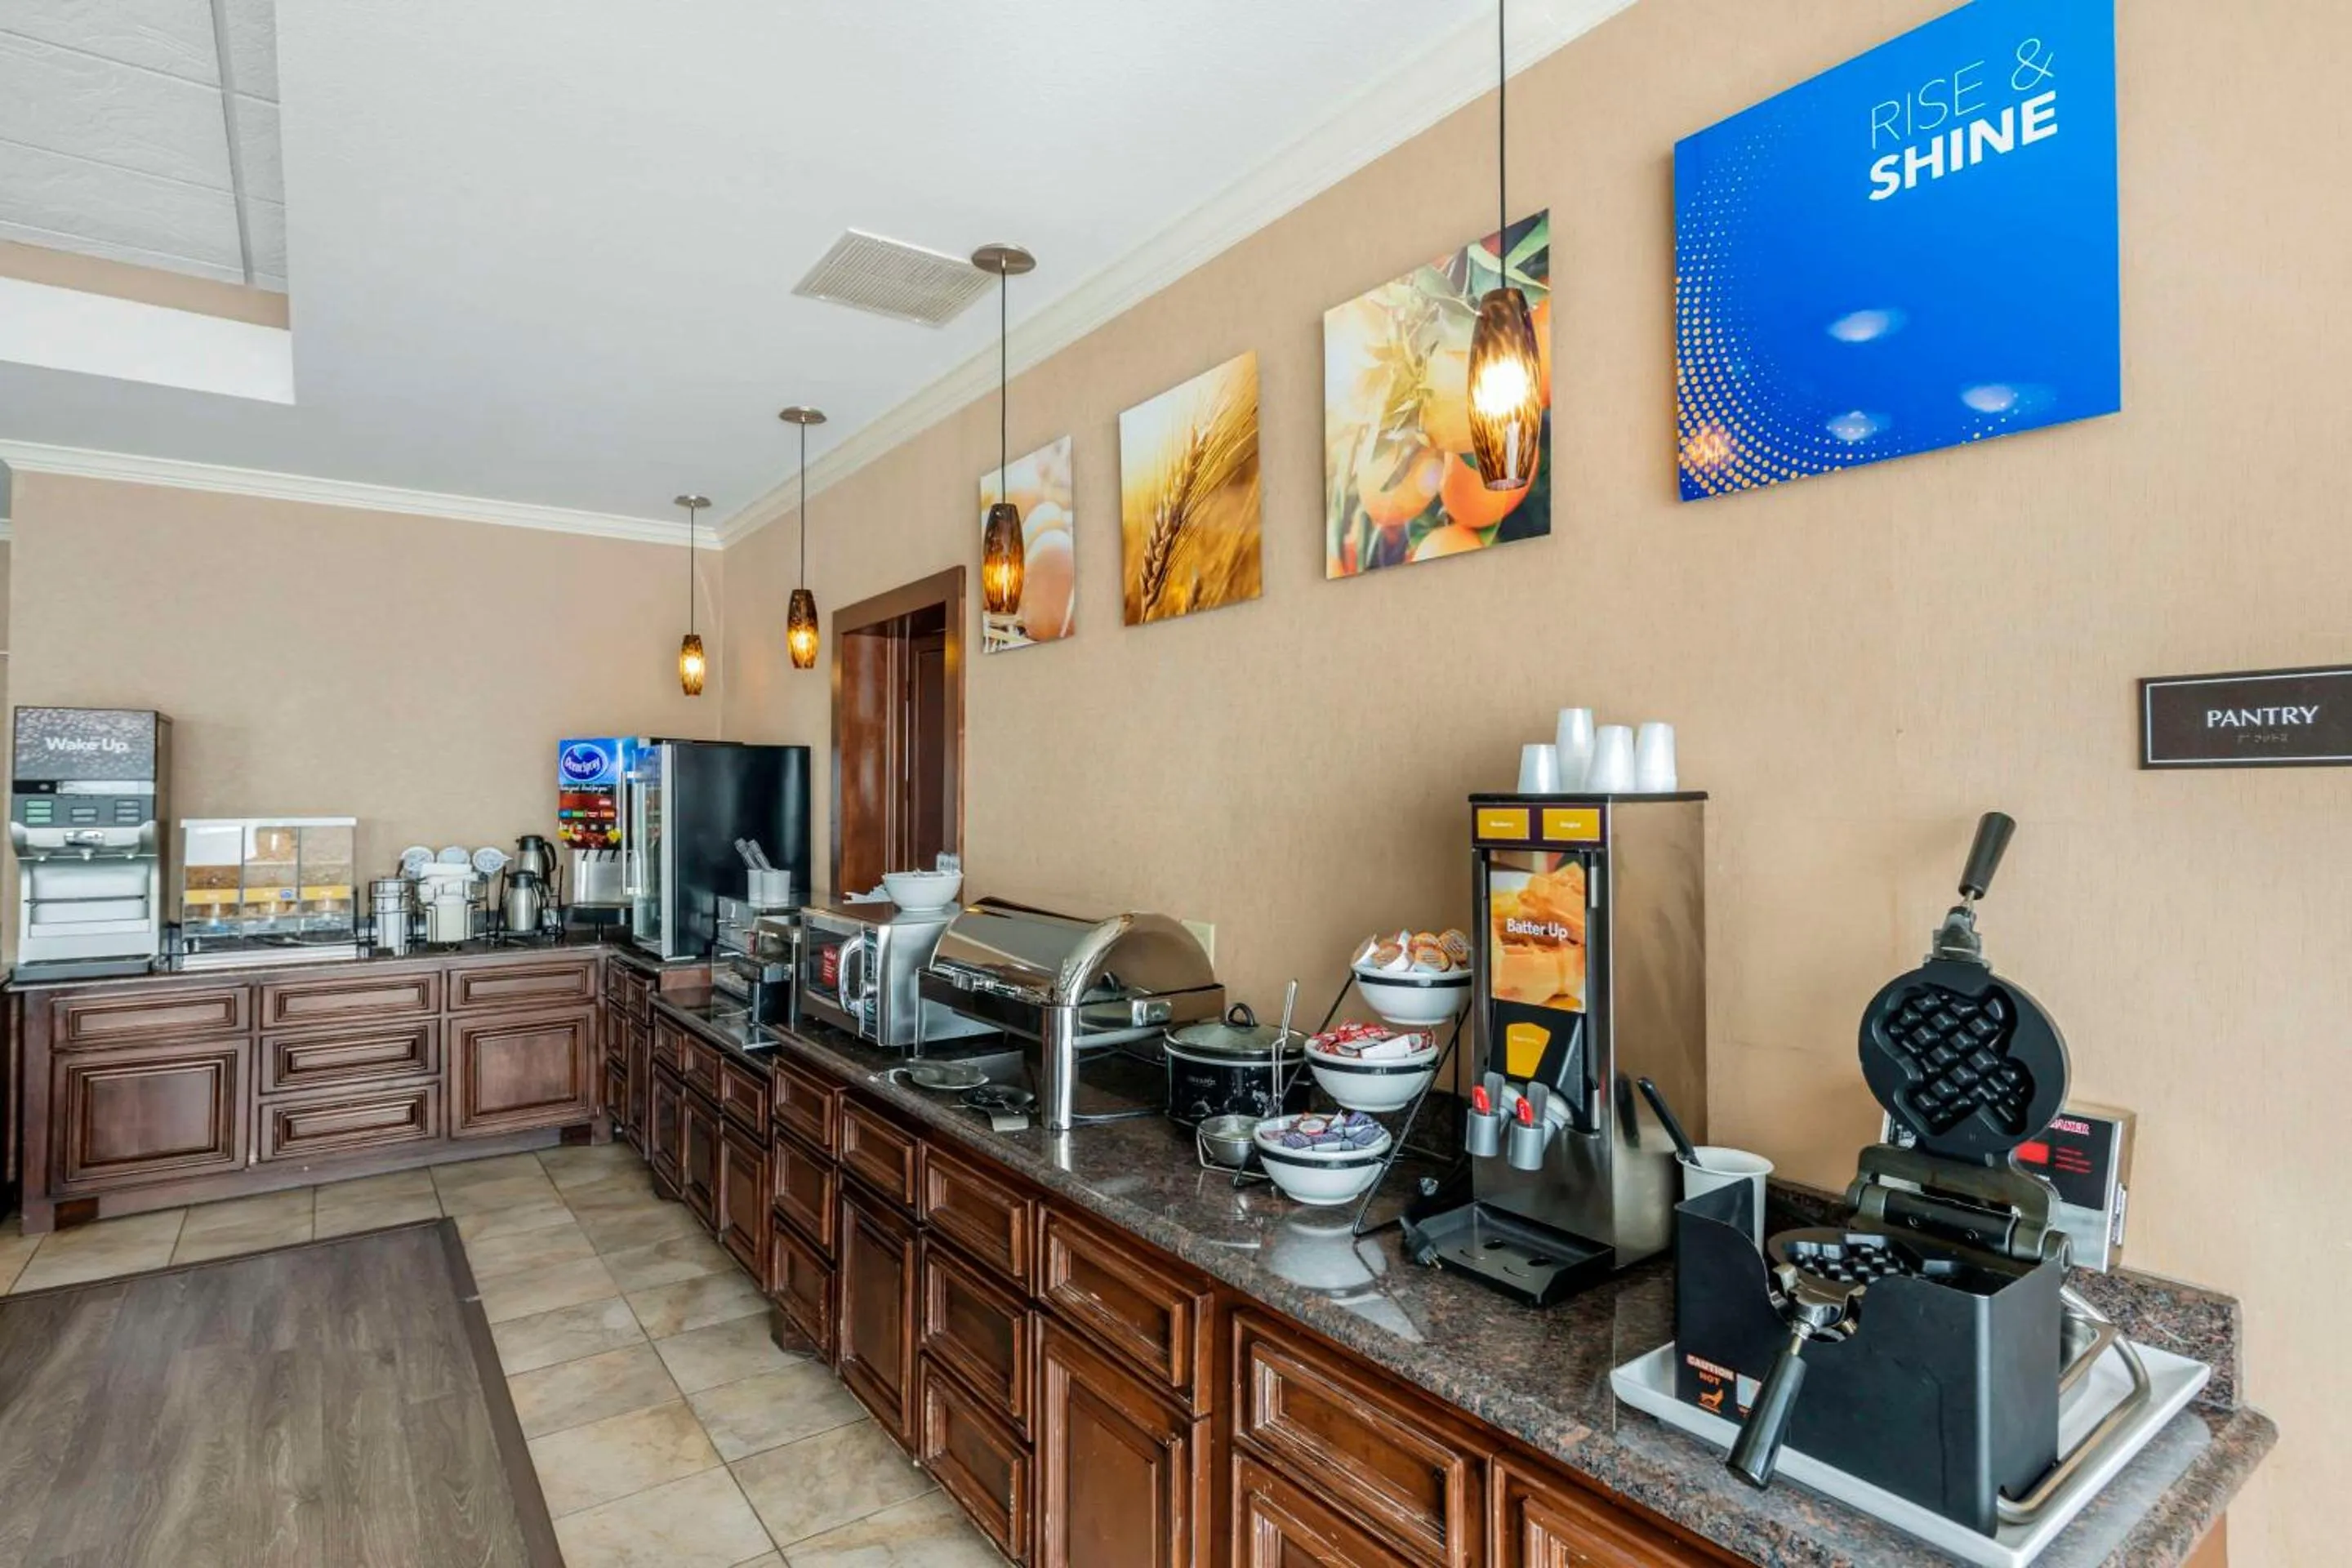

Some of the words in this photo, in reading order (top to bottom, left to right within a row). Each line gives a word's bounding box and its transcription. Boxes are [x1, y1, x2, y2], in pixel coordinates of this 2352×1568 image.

[1871, 60, 1987, 150] RISE
[2011, 38, 2055, 91] &
[1869, 90, 2058, 201] SHINE
[2207, 705, 2319, 728] PANTRY
[45, 737, 100, 751] Wake
[1507, 918, 1546, 936] Batter
[1548, 921, 1568, 942] Up
[1686, 1353, 1735, 1383] CAUTION
[1699, 1370, 1722, 1386] HOT
